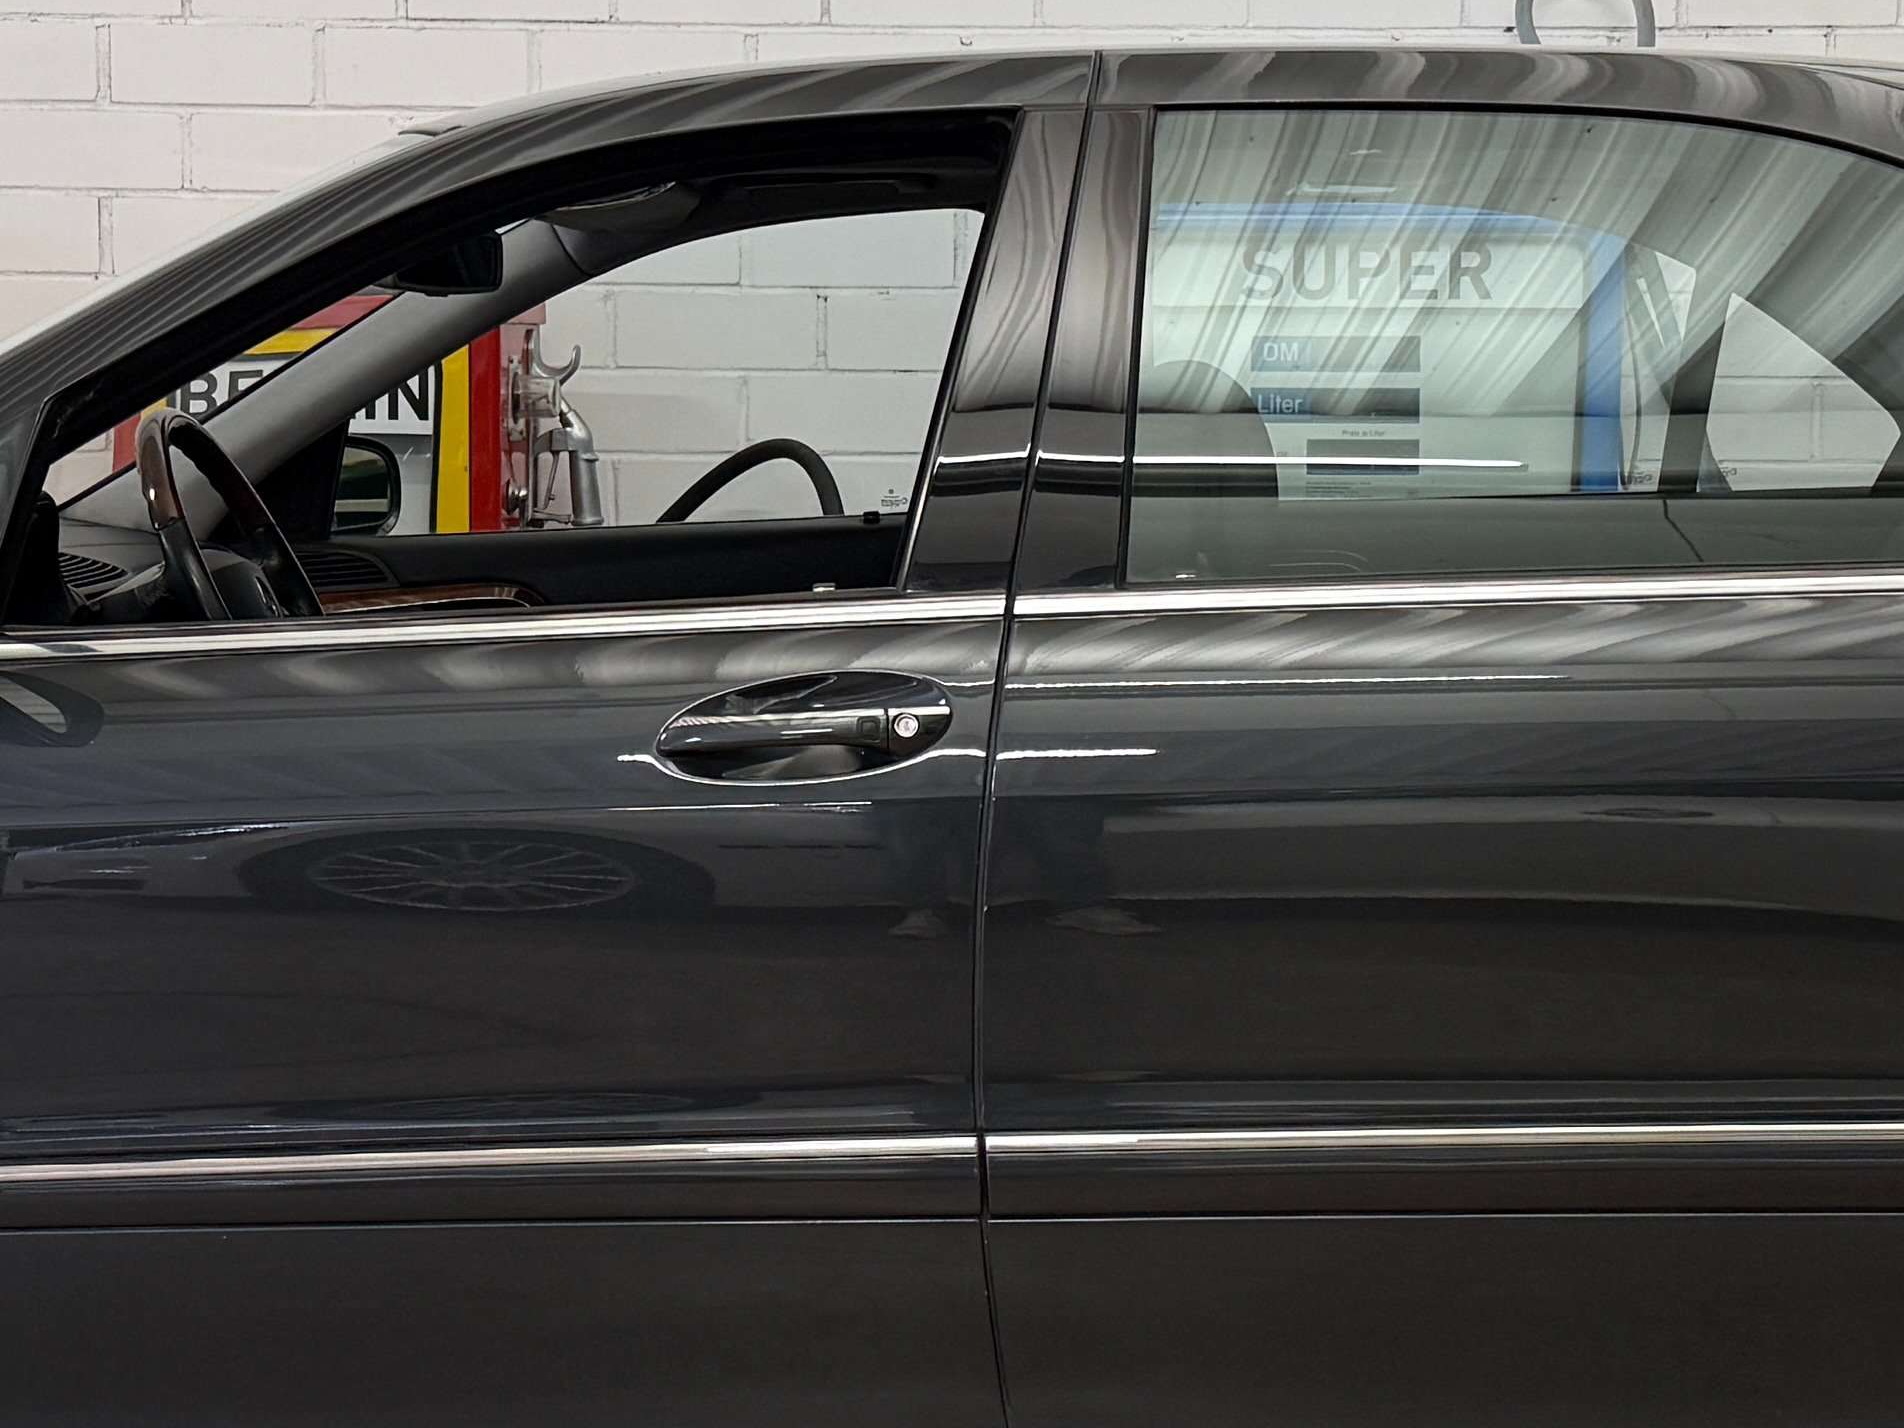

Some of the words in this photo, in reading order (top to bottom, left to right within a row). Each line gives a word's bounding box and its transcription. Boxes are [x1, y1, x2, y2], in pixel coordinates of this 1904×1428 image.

[1241, 242, 1493, 300] SUPER
[1263, 342, 1298, 361] DM
[1257, 394, 1303, 413] Liter
